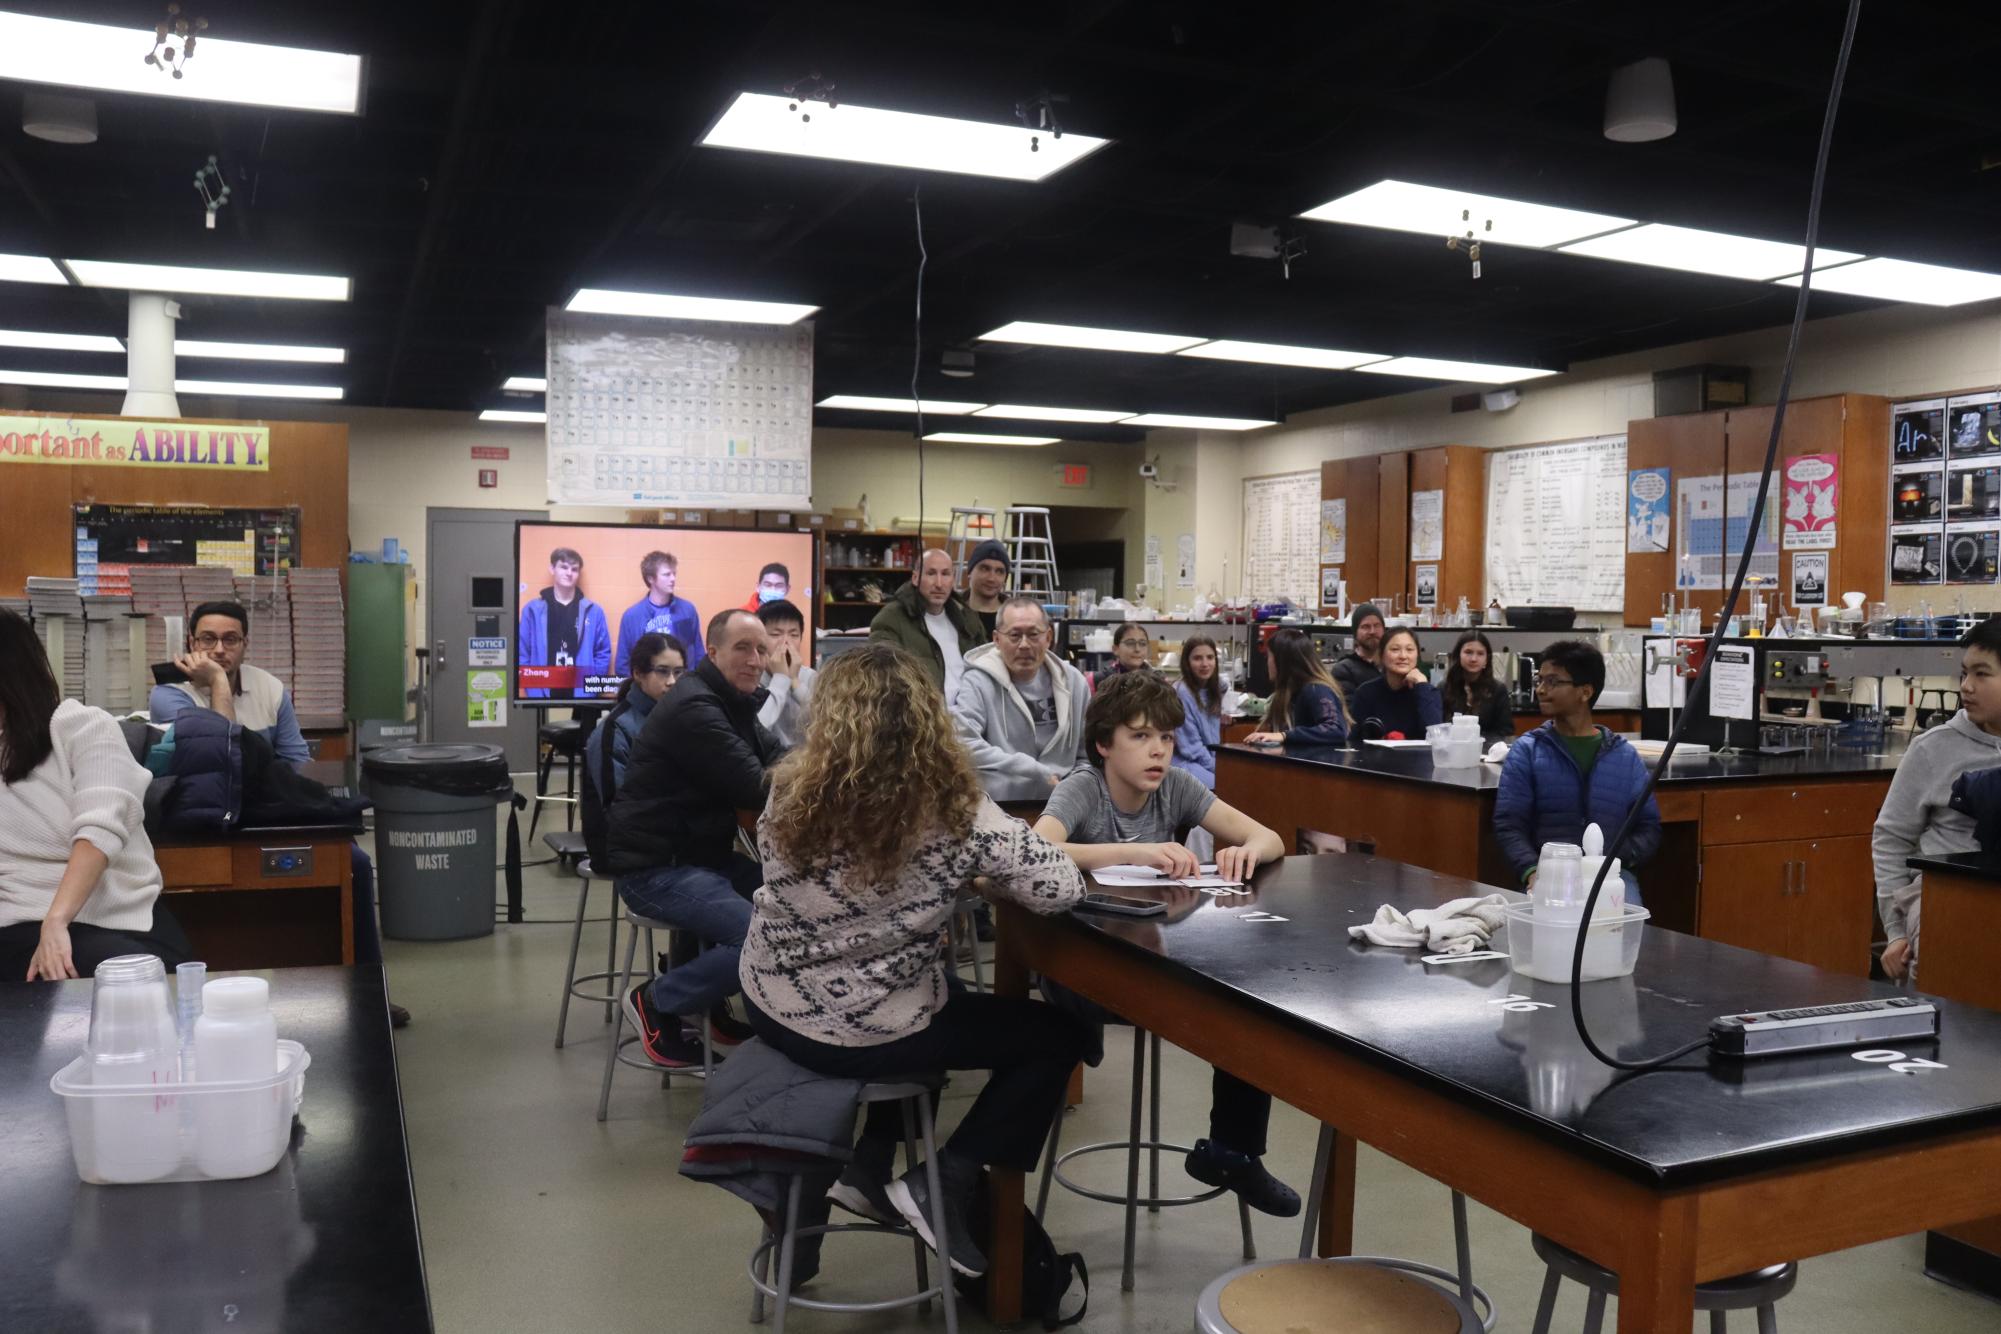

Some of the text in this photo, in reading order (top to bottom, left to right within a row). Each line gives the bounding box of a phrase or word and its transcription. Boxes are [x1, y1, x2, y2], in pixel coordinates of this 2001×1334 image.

[0, 427, 263, 465] ortant as ABILITY.
[1700, 484, 1711, 492] The
[1743, 480, 1760, 488] Table
[109, 505, 121, 514] The
[123, 506, 151, 517] periodic
[193, 508, 225, 517] elements
[1796, 558, 1825, 568] CAUTION
[471, 640, 504, 648] NOTICE
[523, 668, 549, 678] Zhang
[584, 676, 600, 684] with
[585, 685, 601, 693] been
[388, 829, 477, 848] NONCONTAMINATED
[415, 853, 450, 870] WASTE
[1851, 1049, 1949, 1073] 20
